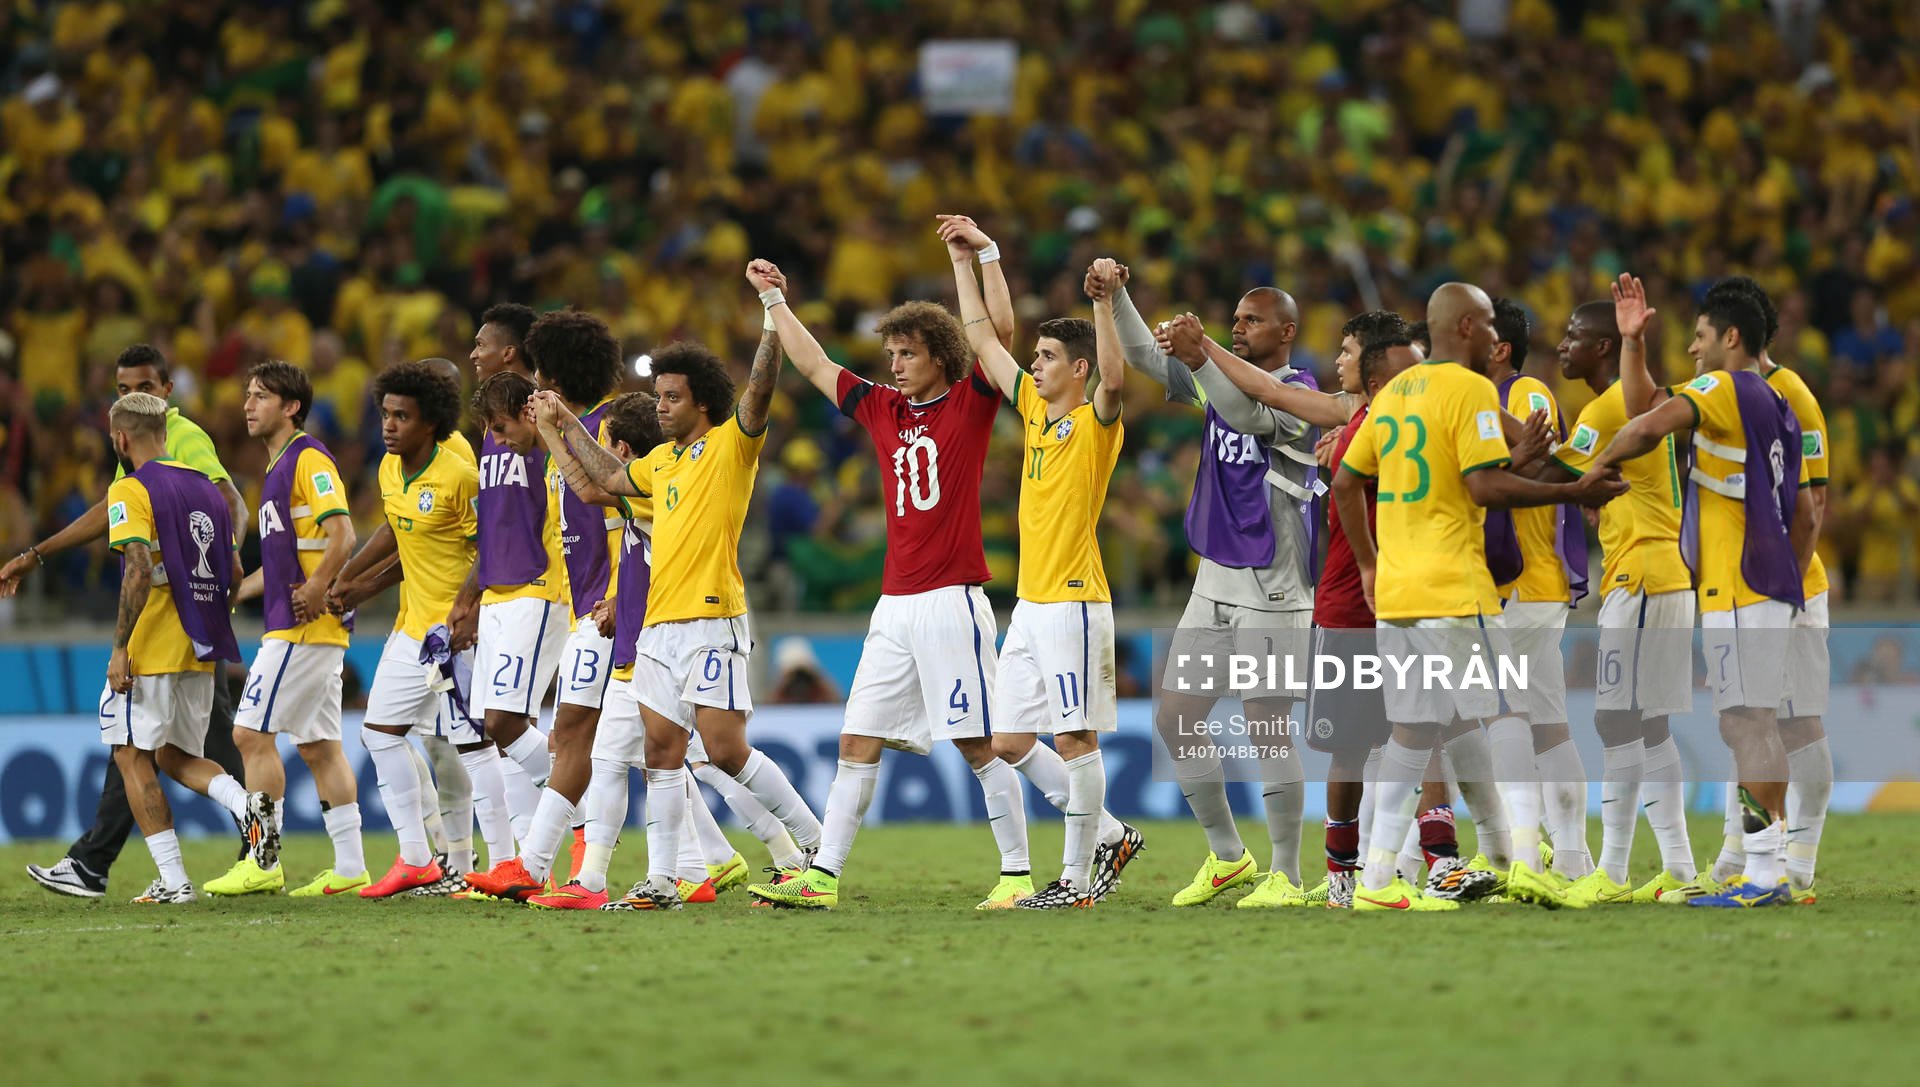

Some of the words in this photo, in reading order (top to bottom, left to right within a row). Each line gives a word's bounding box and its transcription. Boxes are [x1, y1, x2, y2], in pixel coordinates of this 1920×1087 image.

[479, 452, 530, 490] FIFA
[891, 436, 940, 517] 10
[1375, 415, 1430, 502] 23
[493, 653, 524, 689] 21
[571, 649, 599, 683] 13
[704, 649, 721, 681] 6
[1713, 643, 1731, 681] 7
[950, 679, 969, 713] 4
[1056, 672, 1079, 708] 11
